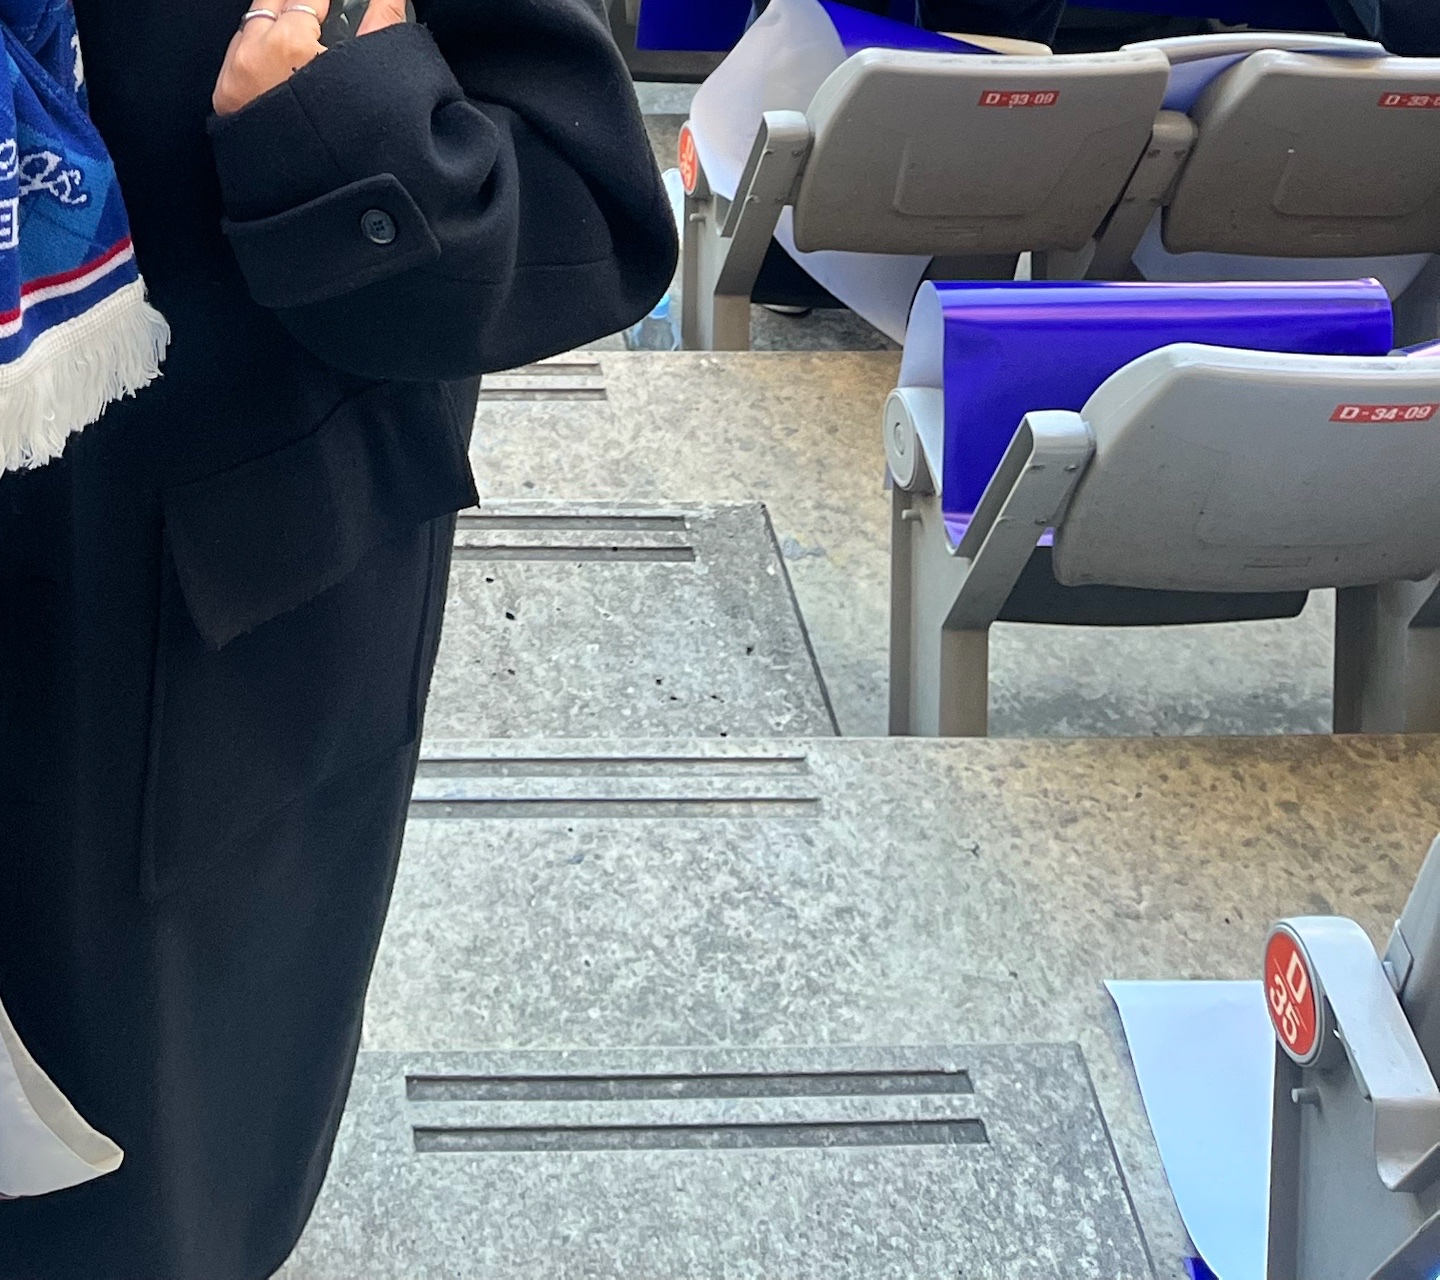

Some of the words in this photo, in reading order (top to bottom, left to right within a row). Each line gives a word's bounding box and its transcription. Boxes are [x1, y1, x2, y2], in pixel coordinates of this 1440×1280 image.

[1339, 405, 1432, 421] D-34-09
[1286, 950, 1308, 1004] D
[1269, 973, 1298, 1045] 35
